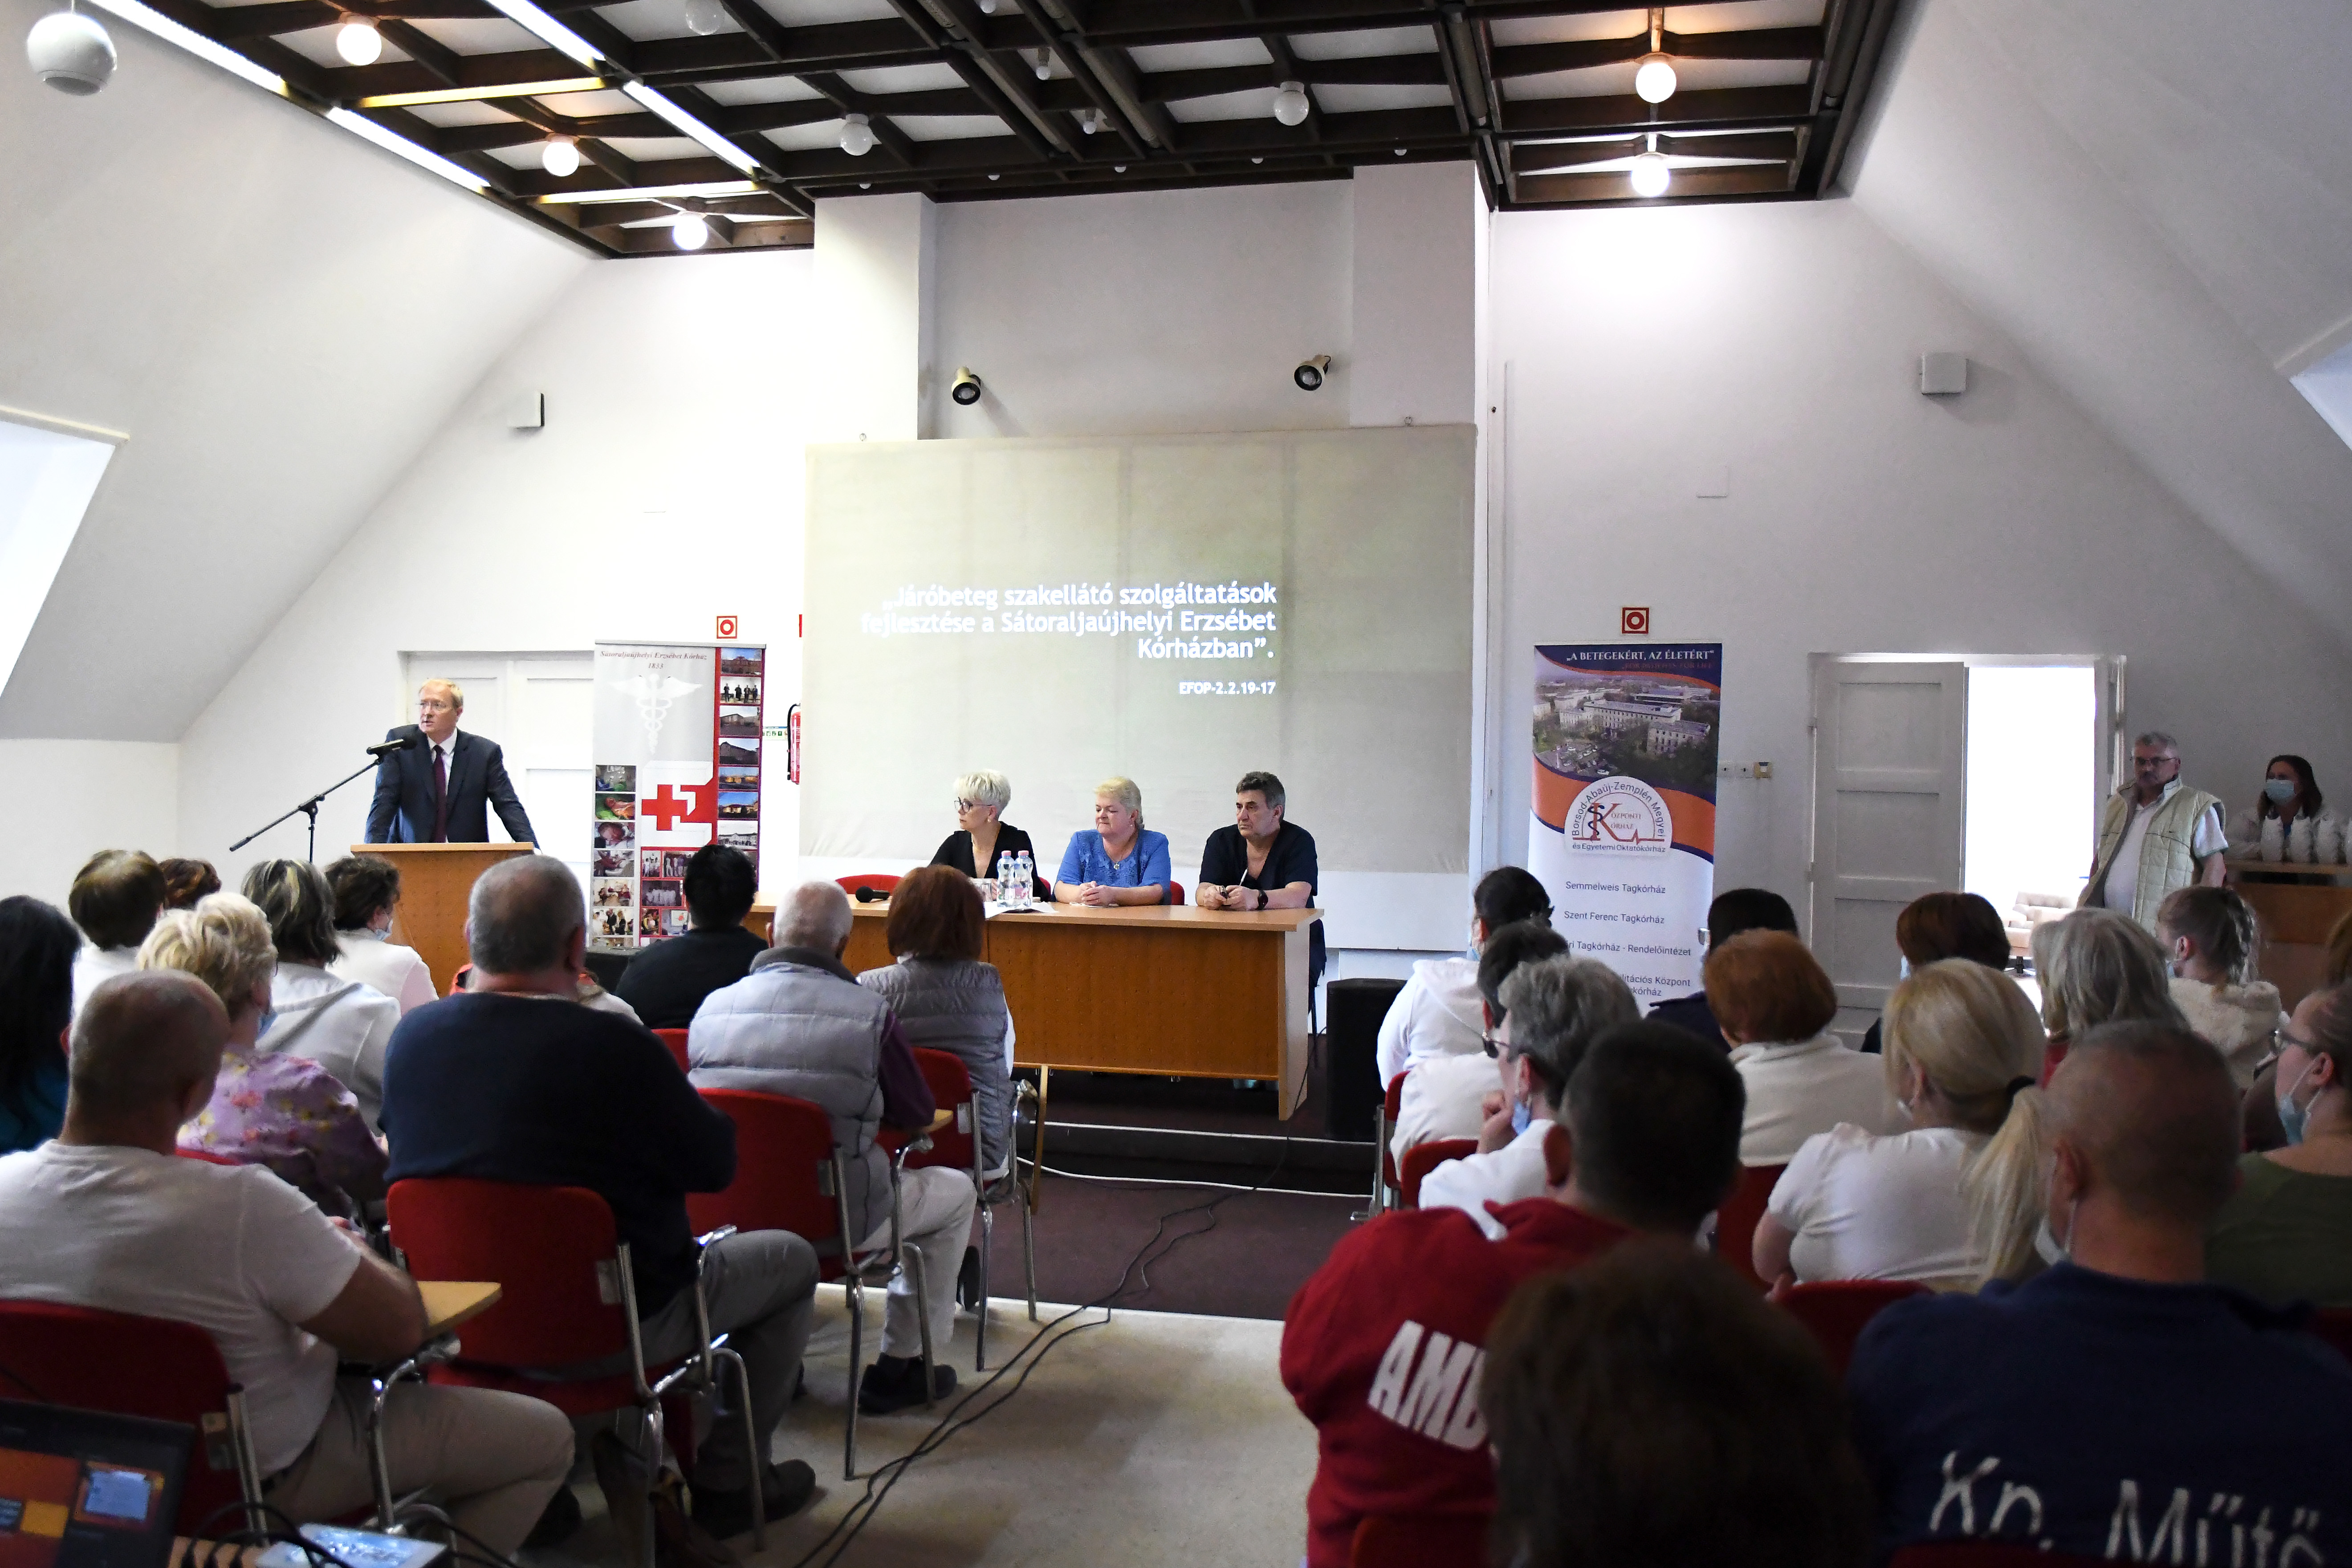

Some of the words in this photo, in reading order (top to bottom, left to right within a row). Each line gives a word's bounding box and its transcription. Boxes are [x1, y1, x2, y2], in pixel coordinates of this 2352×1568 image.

[1004, 582, 1114, 606] szakellátó
[1119, 580, 1277, 609] szolgáltatások
[861, 610, 976, 638] fejlesztése
[982, 616, 994, 632] a
[1001, 609, 1173, 637] Sátoraljaújhelyi
[1180, 608, 1277, 631] Erzsébet
[1580, 650, 1647, 661] BETEGEKÉRT,
[1649, 651, 1662, 660] AZ
[1179, 681, 1277, 695] EFOP-2.2.19-17
[1571, 781, 1652, 836] Borsod-Abaúj-Zemplén
[1651, 801, 1666, 837] Megyei
[1582, 843, 1615, 852] Egyetemi
[1616, 844, 1666, 853] Oktatókórház
[1565, 881, 1620, 892] Semmelweis
[1622, 883, 1666, 894] Tagkórház
[1564, 910, 1587, 919] Szent
[1590, 912, 1619, 921] Ferenc
[1620, 913, 1665, 924] Tagkórház
[1577, 941, 1621, 952] Tagkórház
[1628, 944, 1691, 956] Rendelőintézet
[1655, 976, 1691, 987] Központ
[1632, 986, 1662, 996] kórház
